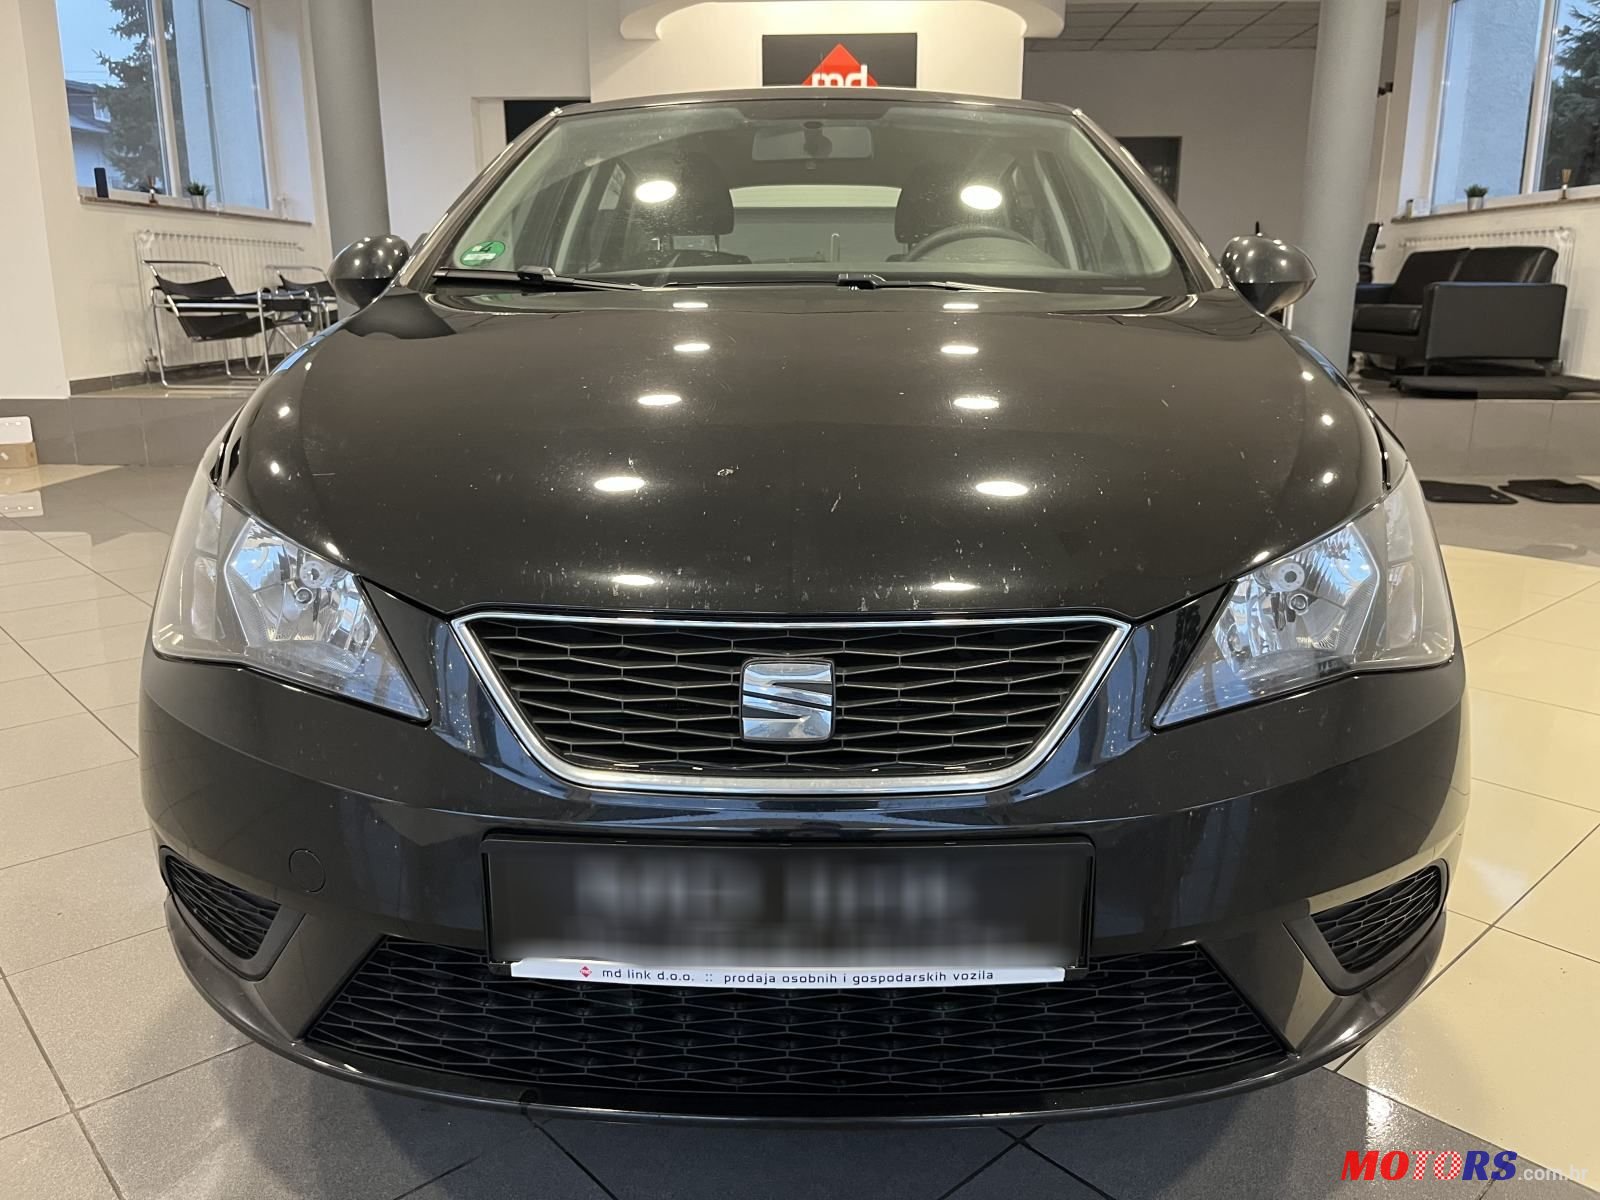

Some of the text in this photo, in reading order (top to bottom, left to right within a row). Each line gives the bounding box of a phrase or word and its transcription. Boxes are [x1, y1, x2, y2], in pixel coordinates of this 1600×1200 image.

[812, 64, 868, 87] md
[602, 968, 622, 978] md
[627, 969, 651, 980] link
[657, 970, 695, 981] d.o.o.
[724, 972, 776, 984] prodaja
[782, 973, 837, 983] osobnih
[852, 971, 947, 985] gospodarskih
[953, 970, 994, 981] vozila
